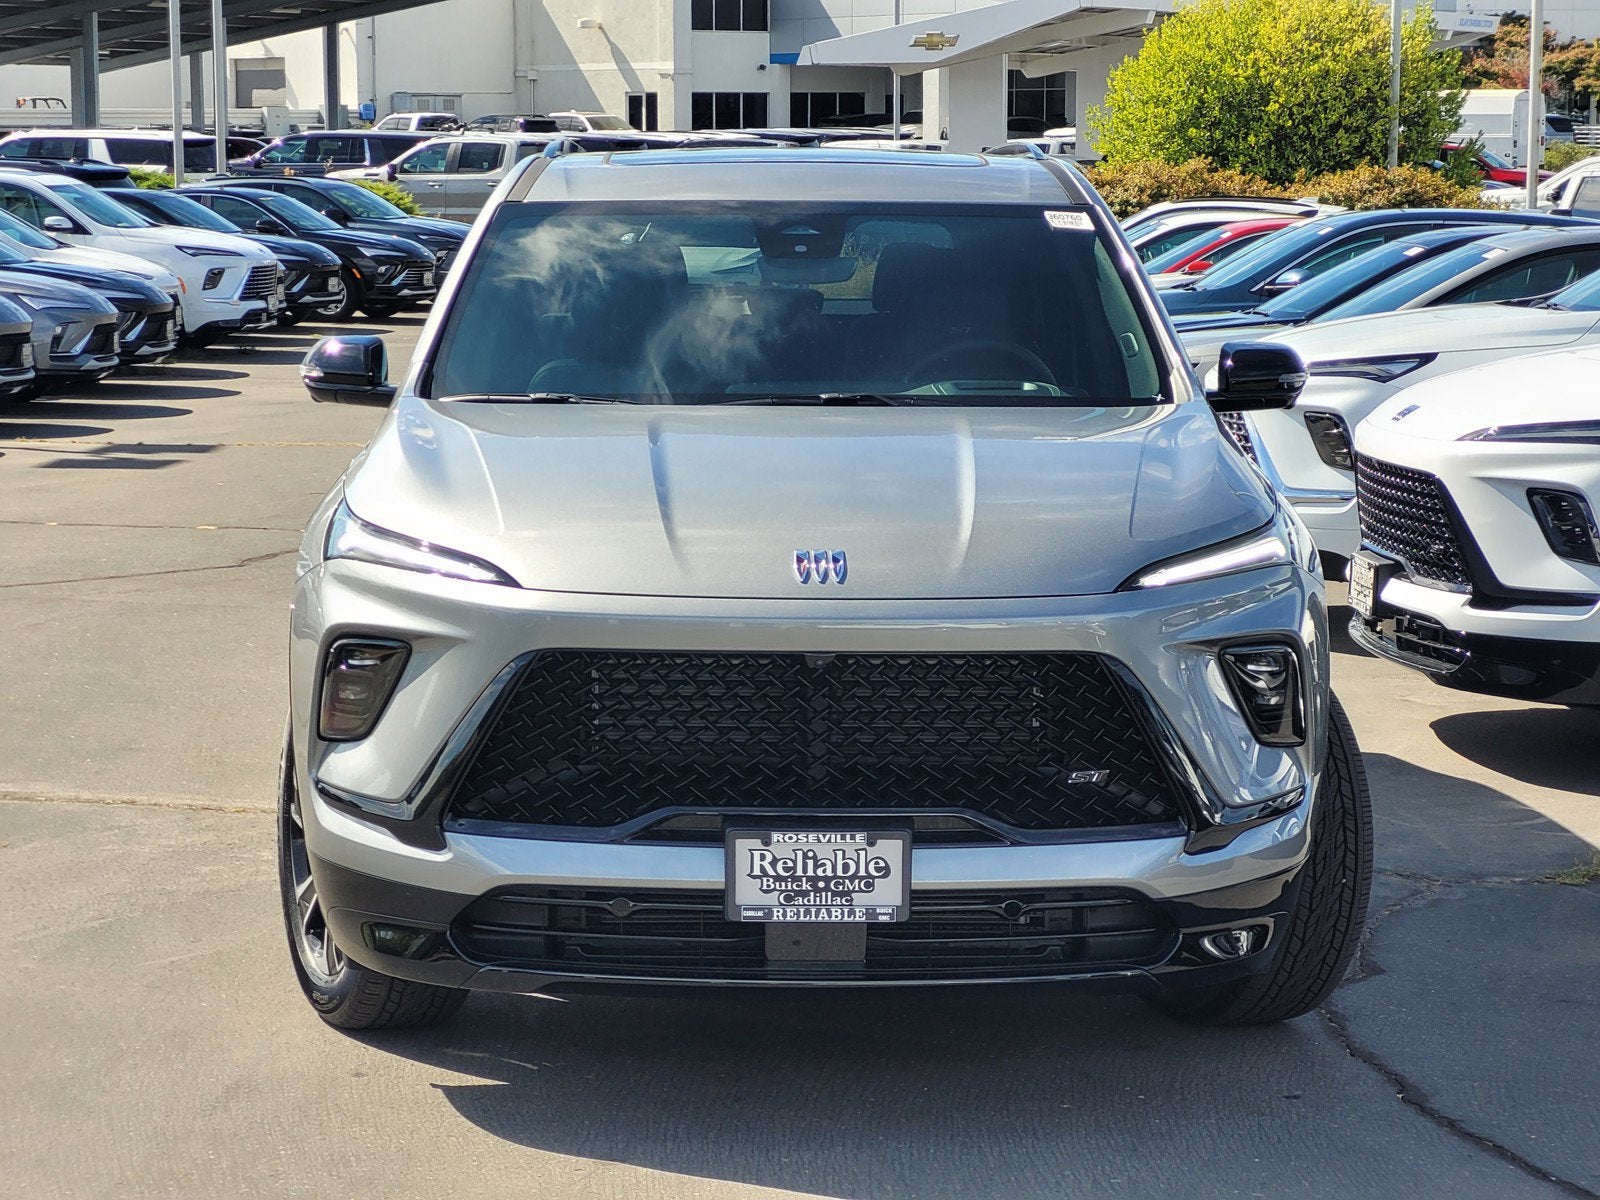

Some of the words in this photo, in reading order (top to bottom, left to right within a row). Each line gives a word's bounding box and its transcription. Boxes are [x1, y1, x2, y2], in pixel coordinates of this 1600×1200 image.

[1068, 769, 1110, 784] ST
[772, 833, 866, 843] ROSEVILLE
[749, 848, 887, 878] Reliable
[761, 877, 814, 891] Buick
[830, 878, 874, 891] GMC
[778, 892, 852, 906] Cadillac
[772, 908, 866, 921] RELIABLE
